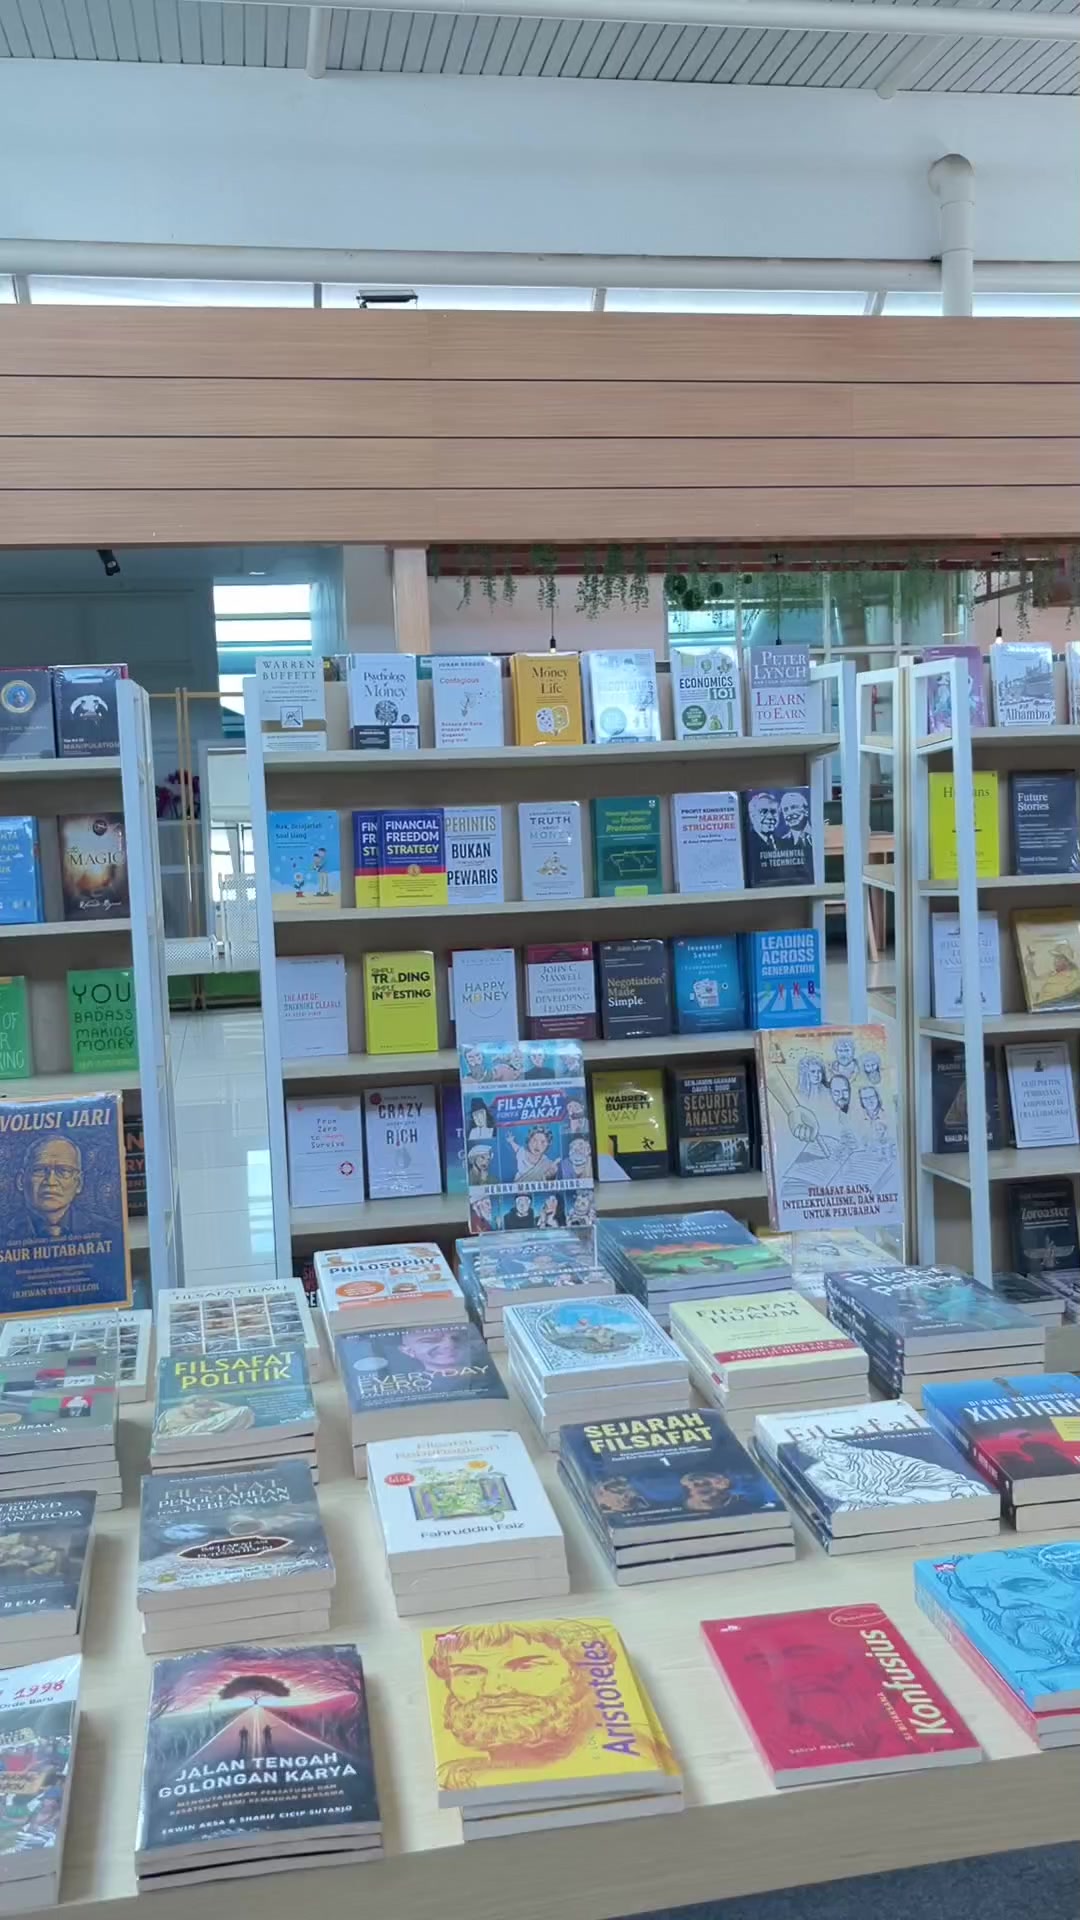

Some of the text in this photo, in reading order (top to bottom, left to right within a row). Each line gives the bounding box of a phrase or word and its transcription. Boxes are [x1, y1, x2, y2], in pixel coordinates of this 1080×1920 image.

[262, 660, 315, 669] WARREN
[762, 651, 806, 665] PETER
[262, 671, 317, 680] BUFFETT
[363, 671, 406, 684] Psychology
[532, 667, 568, 679] Money
[754, 664, 806, 679] LYNCH
[541, 684, 562, 694] Life
[680, 676, 733, 689] ECONOMICS
[364, 685, 407, 698] Money
[711, 688, 733, 700] 101
[756, 691, 806, 706] LEARN
[774, 707, 806, 719] EARN
[1005, 707, 1050, 721] Alhambra
[1018, 792, 1048, 802] Future
[1018, 802, 1049, 811] Stories
[445, 815, 496, 832] PERINTIS
[530, 816, 571, 825] TRUTH
[698, 814, 735, 822] MARKET
[385, 820, 439, 831] FINANCIAL
[682, 823, 736, 832] STRUCTURE
[386, 832, 440, 843] FREEDOM
[387, 844, 439, 855] STRATEGY
[451, 843, 491, 859] BUKAN
[70, 851, 124, 865] MAGIC
[447, 869, 498, 886] PEWARIS
[761, 934, 814, 950] LEADING
[761, 949, 815, 965] ACROSS
[761, 964, 816, 976] GENERATION
[372, 972, 430, 984] TRADING
[540, 973, 582, 982] MAXWELL
[608, 976, 662, 988] Negotiation
[72, 982, 131, 1004] YOU
[464, 981, 505, 992] HAPPY
[608, 987, 636, 997] Made
[372, 989, 431, 1000] INVESTING
[462, 992, 509, 1003] MONEY
[535, 993, 590, 1003] DEVELOPING
[74, 1009, 133, 1023] BADASS
[76, 1025, 134, 1039] MAKING
[77, 1038, 134, 1053] MONEY
[497, 1093, 562, 1111] FILSAFAT
[605, 1094, 647, 1102] WARREN
[684, 1093, 740, 1111] SECURITY
[378, 1103, 423, 1120] CRAZY
[520, 1105, 562, 1120] BAKAT
[605, 1102, 651, 1111] BUFFETT
[67, 1108, 110, 1127] JARI
[608, 1111, 639, 1121] WAY
[685, 1109, 740, 1127] ANALYSIS
[386, 1129, 418, 1146] RICH
[808, 1184, 872, 1197] FILSAFAT SAINS,
[782, 1193, 898, 1210] INTELEKTUALISME, DAN RISET
[803, 1205, 880, 1220] UNTUK PERUBAHAN
[0, 1249, 31, 1262] SAUR
[33, 1240, 113, 1259] HUTABARAT
[329, 1257, 436, 1274] PHILOSOPHY
[696, 1301, 799, 1318] FILSAFAT
[710, 1309, 800, 1324] HUKUM
[174, 1351, 296, 1376] FILSAFAT
[182, 1366, 292, 1390] POLITIK
[583, 1412, 705, 1438] SEJARAH
[784, 1414, 922, 1442] Filsafat
[590, 1426, 713, 1454] FILSAFAT
[496, 1521, 526, 1532] Faiz
[859, 1628, 955, 1736] Konfusius
[13, 1679, 66, 1700] 1998
[575, 1639, 641, 1757] Aristoteles
[175, 1752, 338, 1783] JALAN TENGAH
[158, 1763, 358, 1799] GOLONGAN KARYA
[162, 1823, 196, 1835] ERWIN
[199, 1819, 226, 1829] AKSA
[239, 1813, 276, 1824] SHARIF
[279, 1810, 306, 1819] CICIP
